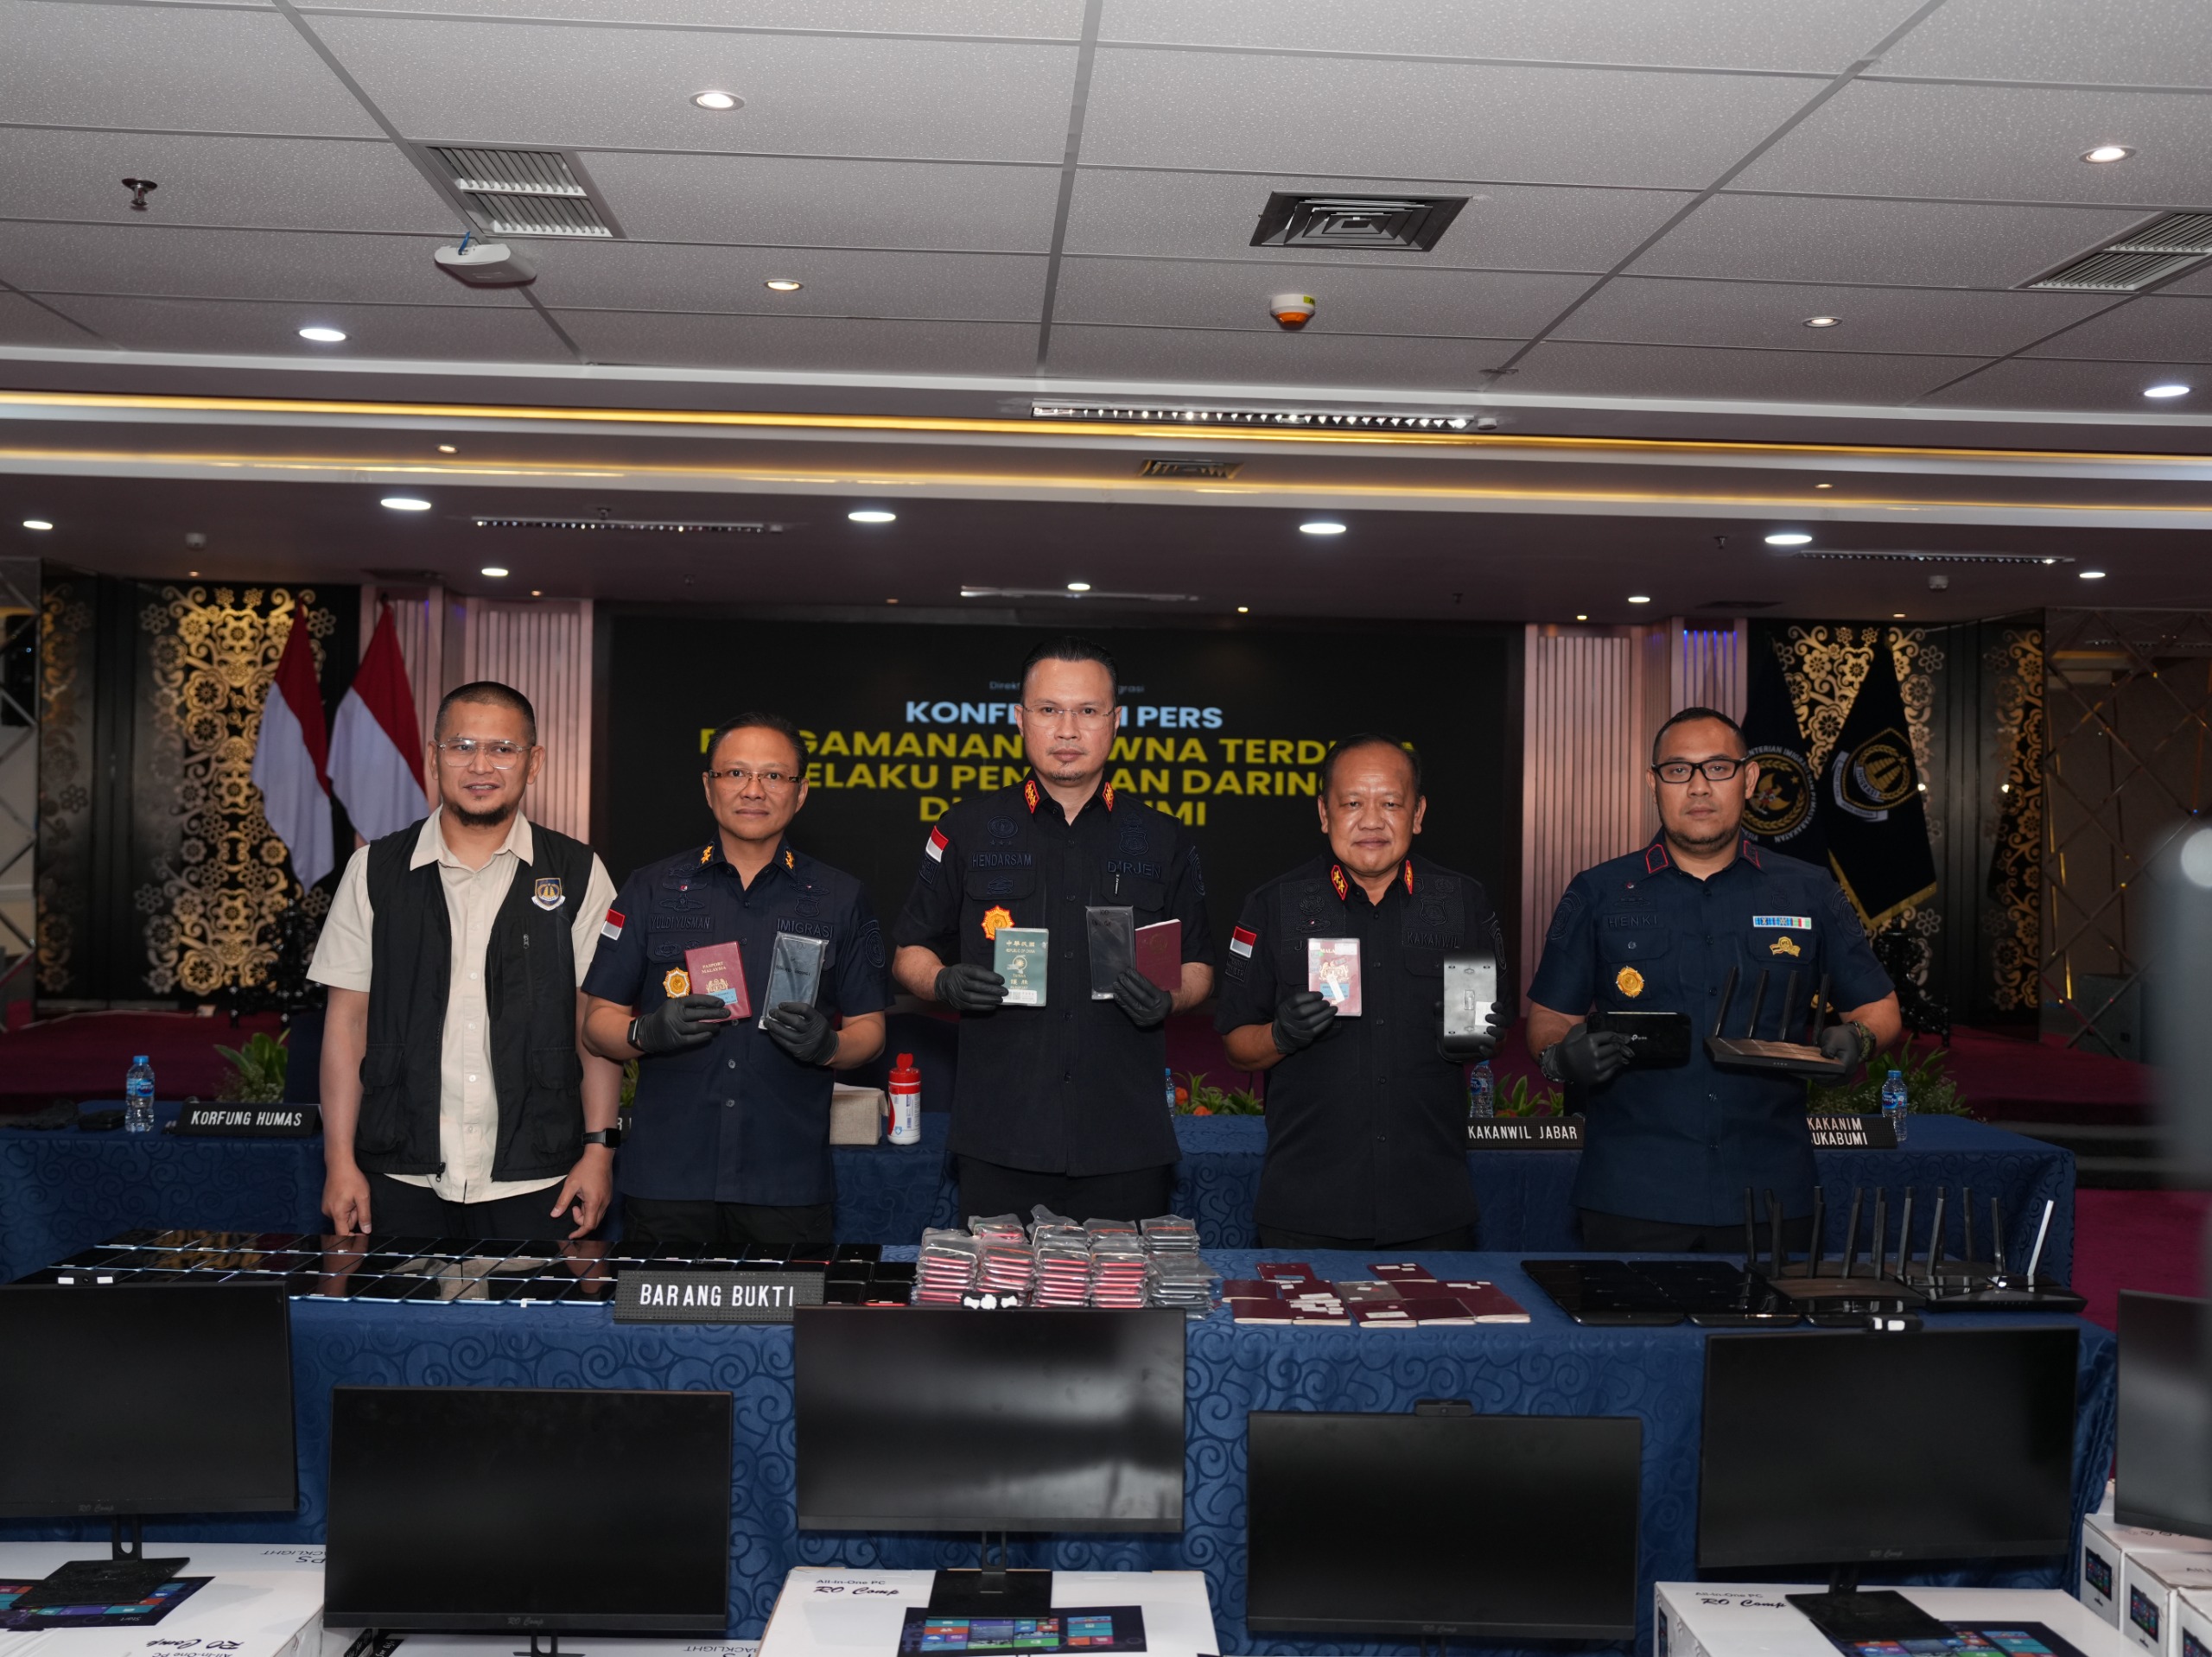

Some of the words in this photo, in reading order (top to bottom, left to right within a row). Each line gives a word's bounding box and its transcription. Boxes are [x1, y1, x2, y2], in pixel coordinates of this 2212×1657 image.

[1137, 705, 1223, 728] PERS
[1219, 739, 1414, 765] TERD
[1748, 745, 1783, 757] NTERIAN
[804, 763, 938, 789] ELAKU
[1182, 769, 1323, 797] DARIN
[972, 853, 1032, 867] HENDARSAM
[1108, 860, 1161, 879] DIRJEN
[777, 917, 834, 938] IMIGRASI
[1607, 914, 1658, 928] HENKI
[190, 1110, 251, 1126] KORFUNG
[256, 1111, 302, 1127] HUMAS
[1806, 1117, 1863, 1131] KAKANIM
[1467, 1126, 1532, 1140] KAKANWIL
[1539, 1126, 1578, 1140] JABAR
[1810, 1132, 1868, 1146] UKABUMI
[639, 1283, 721, 1307] BARANG
[731, 1286, 794, 1307] BUKTI
[852, 1587, 899, 1596] Comp
[1740, 1599, 1787, 1609] Comp
